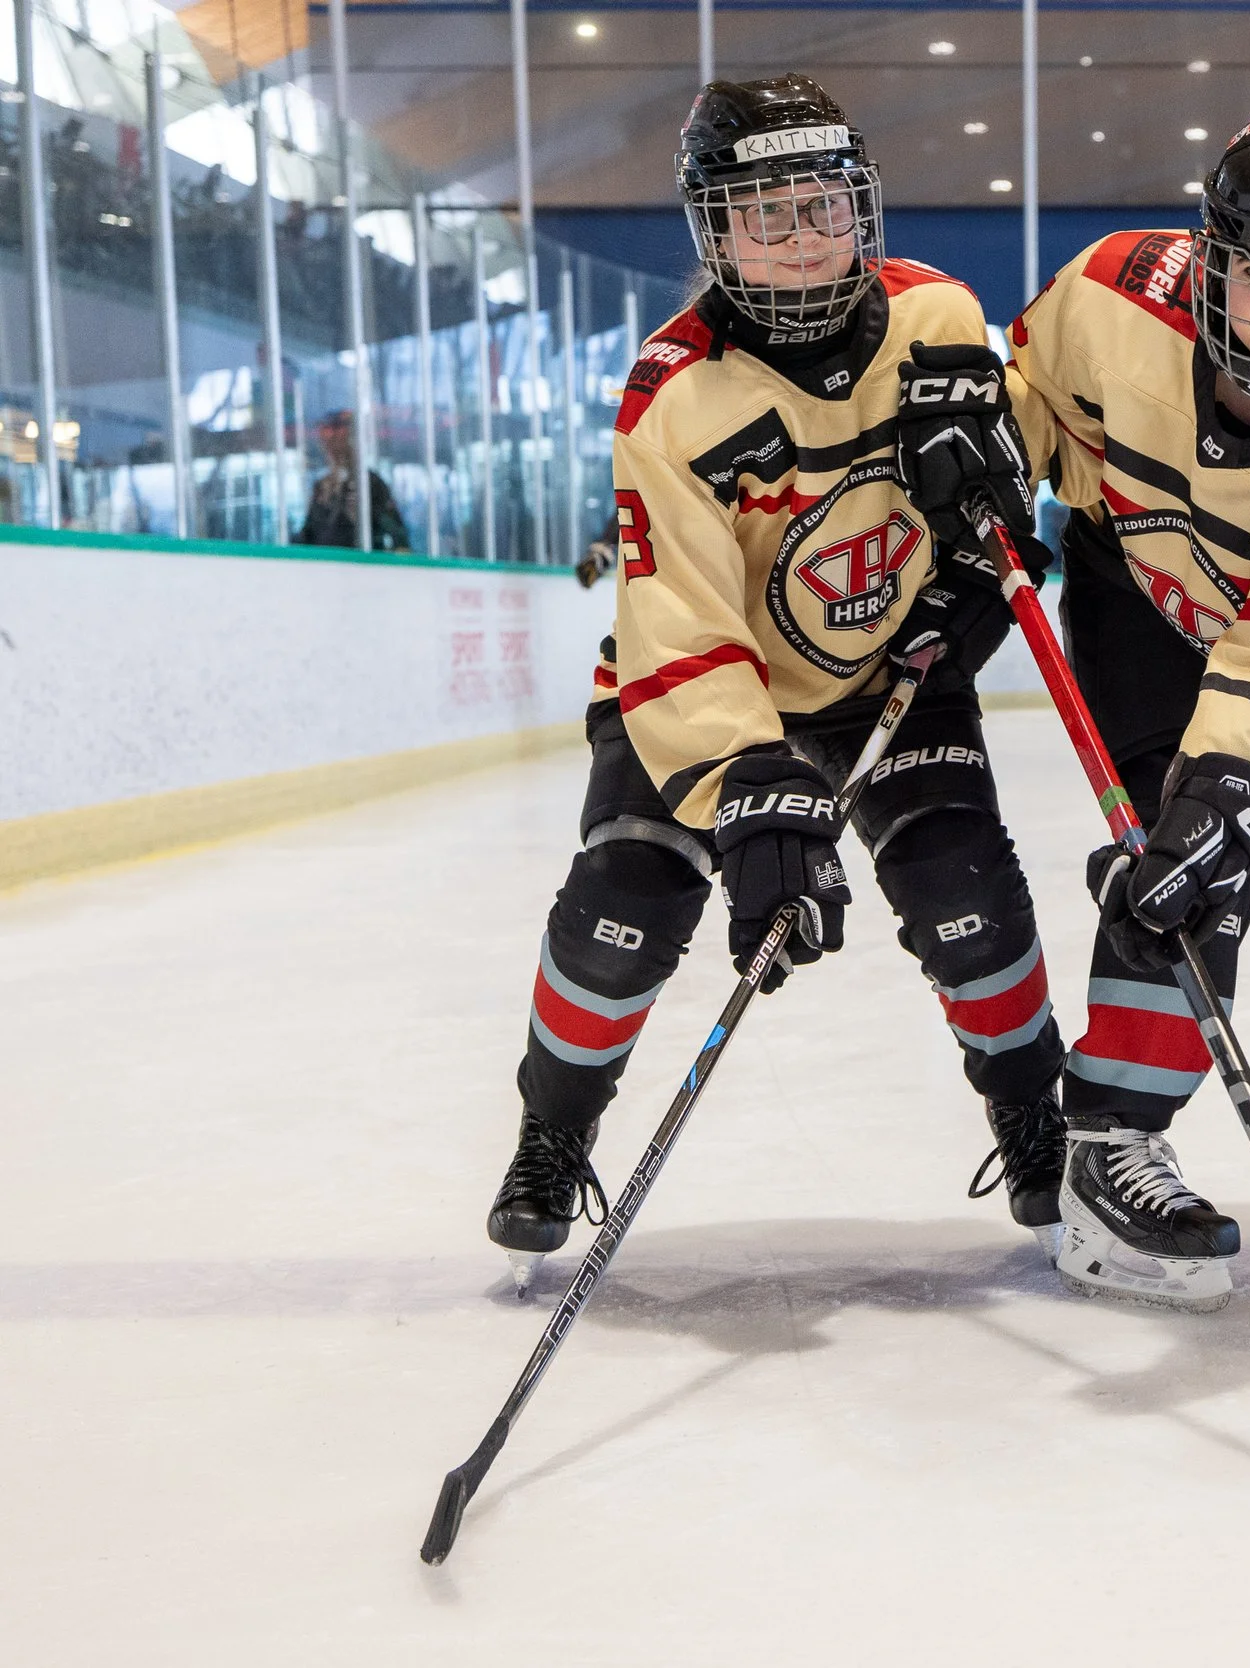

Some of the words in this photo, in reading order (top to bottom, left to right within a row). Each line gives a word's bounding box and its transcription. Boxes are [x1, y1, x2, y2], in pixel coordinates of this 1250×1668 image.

[743, 128, 844, 157] KAITLYN
[777, 523, 804, 565] HOCKEY
[835, 578, 894, 622] HEROS
[1218, 579, 1240, 605] OUT
[772, 597, 794, 632] HOCKEY
[790, 634, 804, 646] ET
[1155, 873, 1187, 906] CCM
[593, 917, 644, 950] BD
[936, 913, 983, 942] BD
